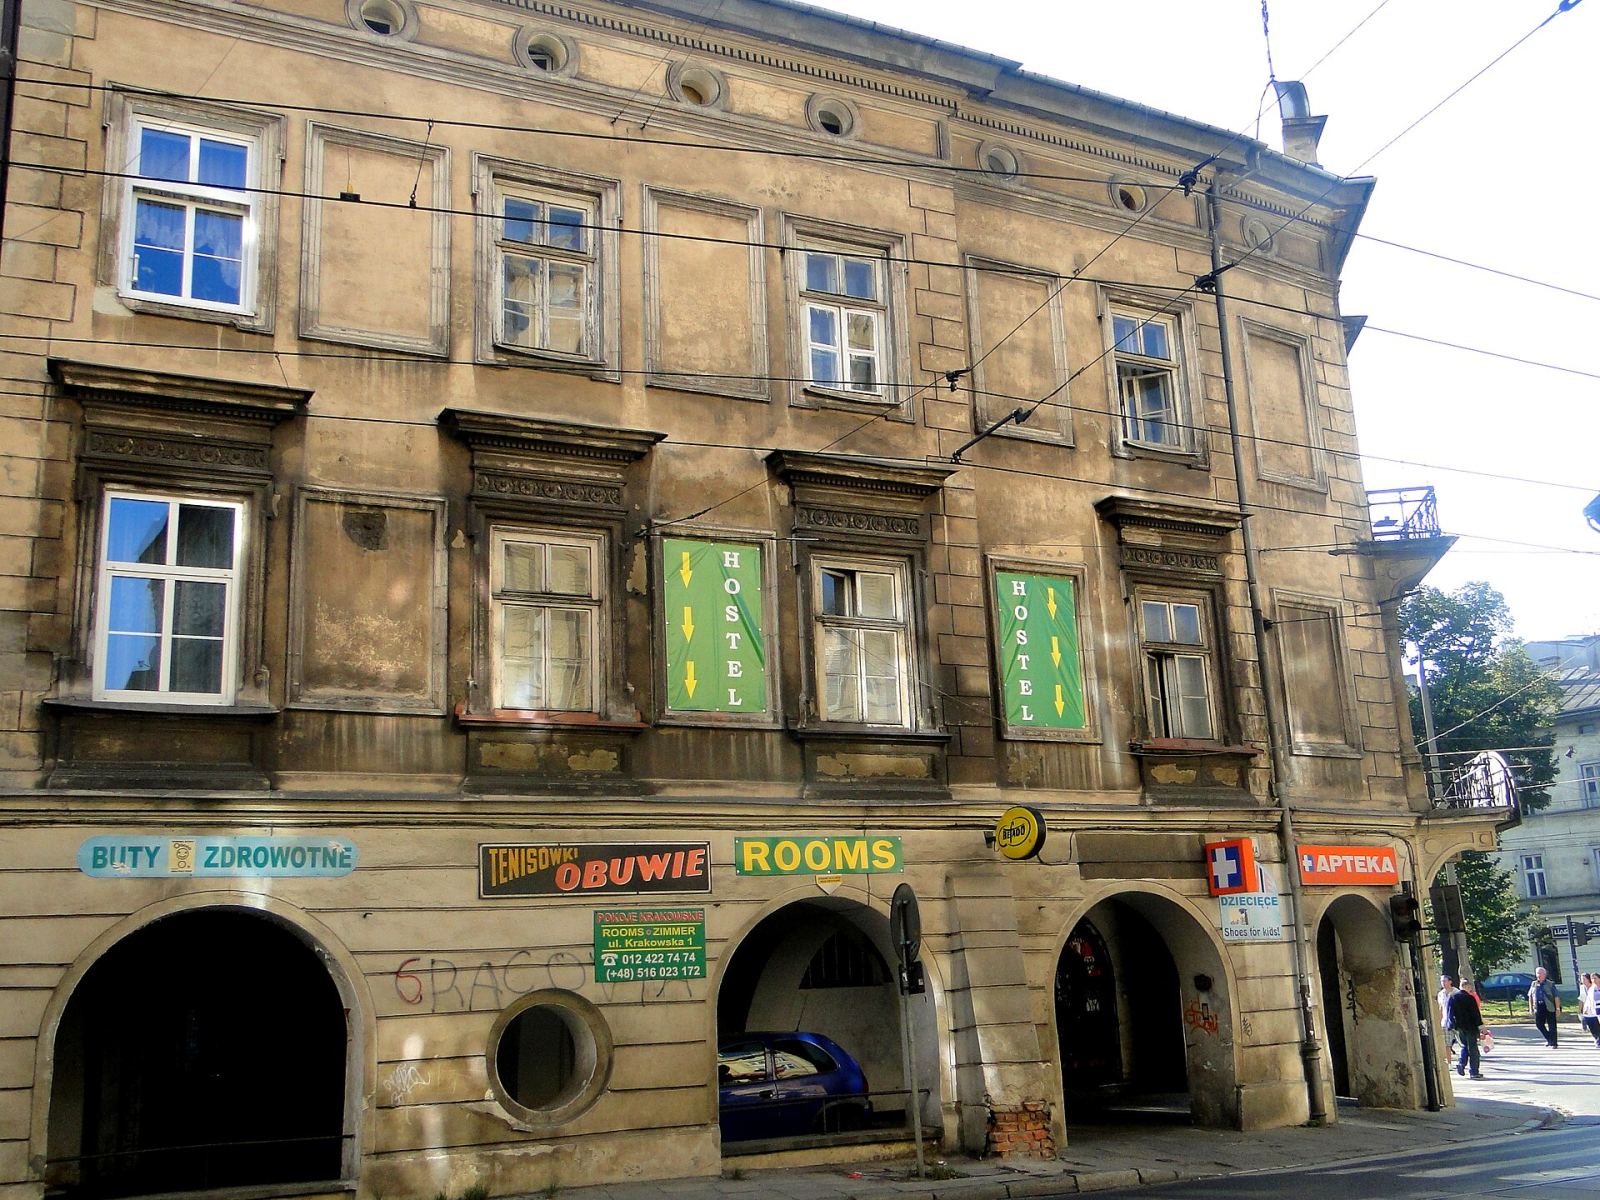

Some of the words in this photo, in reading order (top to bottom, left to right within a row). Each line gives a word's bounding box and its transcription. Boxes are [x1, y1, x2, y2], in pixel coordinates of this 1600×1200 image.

[723, 551, 743, 706] HOSTEL
[1011, 581, 1034, 721] HOSTEL
[92, 846, 161, 869] BUTY
[204, 846, 353, 869] ZDROWOTNE
[743, 840, 896, 871] ROOMS
[1316, 854, 1395, 873] APTEKA
[489, 846, 579, 887] TENISÓWKI
[554, 849, 706, 891] OBUWIE
[597, 912, 638, 922] POKOJE
[639, 911, 704, 921] KRAKOWSKIE
[602, 928, 644, 937] ROOMS
[653, 926, 696, 936] ZIMMER
[1224, 927, 1248, 937] Shoes
[1250, 927, 1261, 936] for
[1263, 926, 1281, 936] kids!
[608, 940, 622, 948] ul.
[625, 938, 684, 948] Krakowska
[687, 937, 693, 946] 1
[622, 954, 642, 964] 012
[645, 953, 665, 964] 422
[667, 953, 681, 963] 74
[683, 952, 696, 962] 74
[606, 968, 634, 981] (+48)
[637, 967, 657, 977] 516
[659, 967, 679, 977] 023
[682, 966, 701, 976] 172
